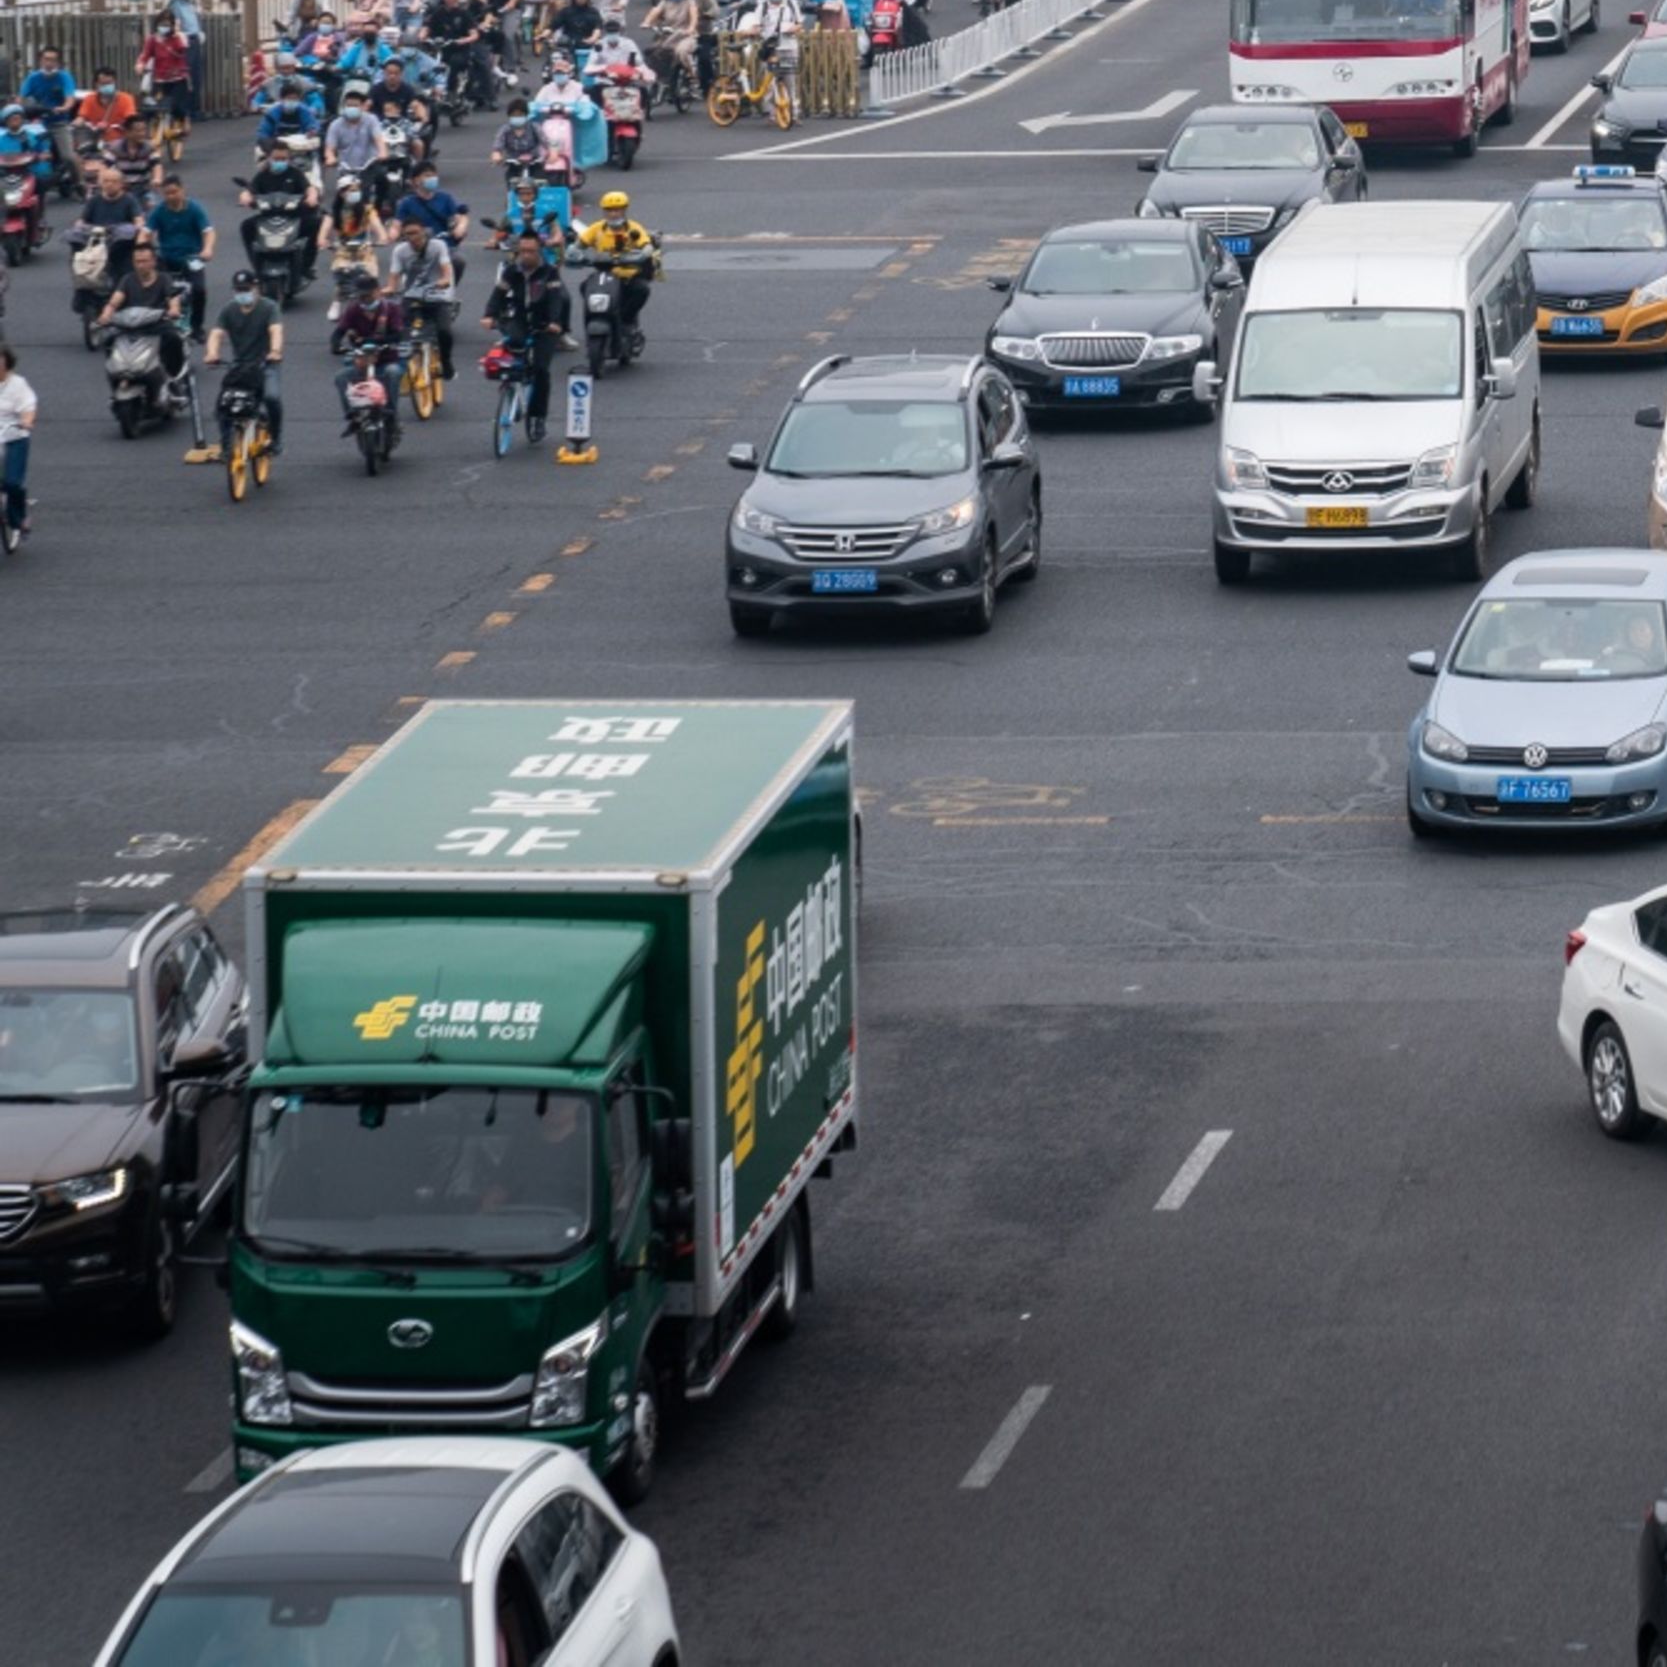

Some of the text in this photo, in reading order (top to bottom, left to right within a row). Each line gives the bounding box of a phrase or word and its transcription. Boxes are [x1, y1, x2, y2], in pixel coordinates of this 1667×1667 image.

[435, 715, 683, 858] 北京邮政
[1523, 780, 1569, 799] 76567
[767, 852, 843, 1038] 中国邮政
[414, 1024, 538, 1040] CHINA POST
[418, 999, 543, 1024] 中国邮政
[767, 1021, 809, 1118] CHINA
[812, 972, 844, 1060] POST
